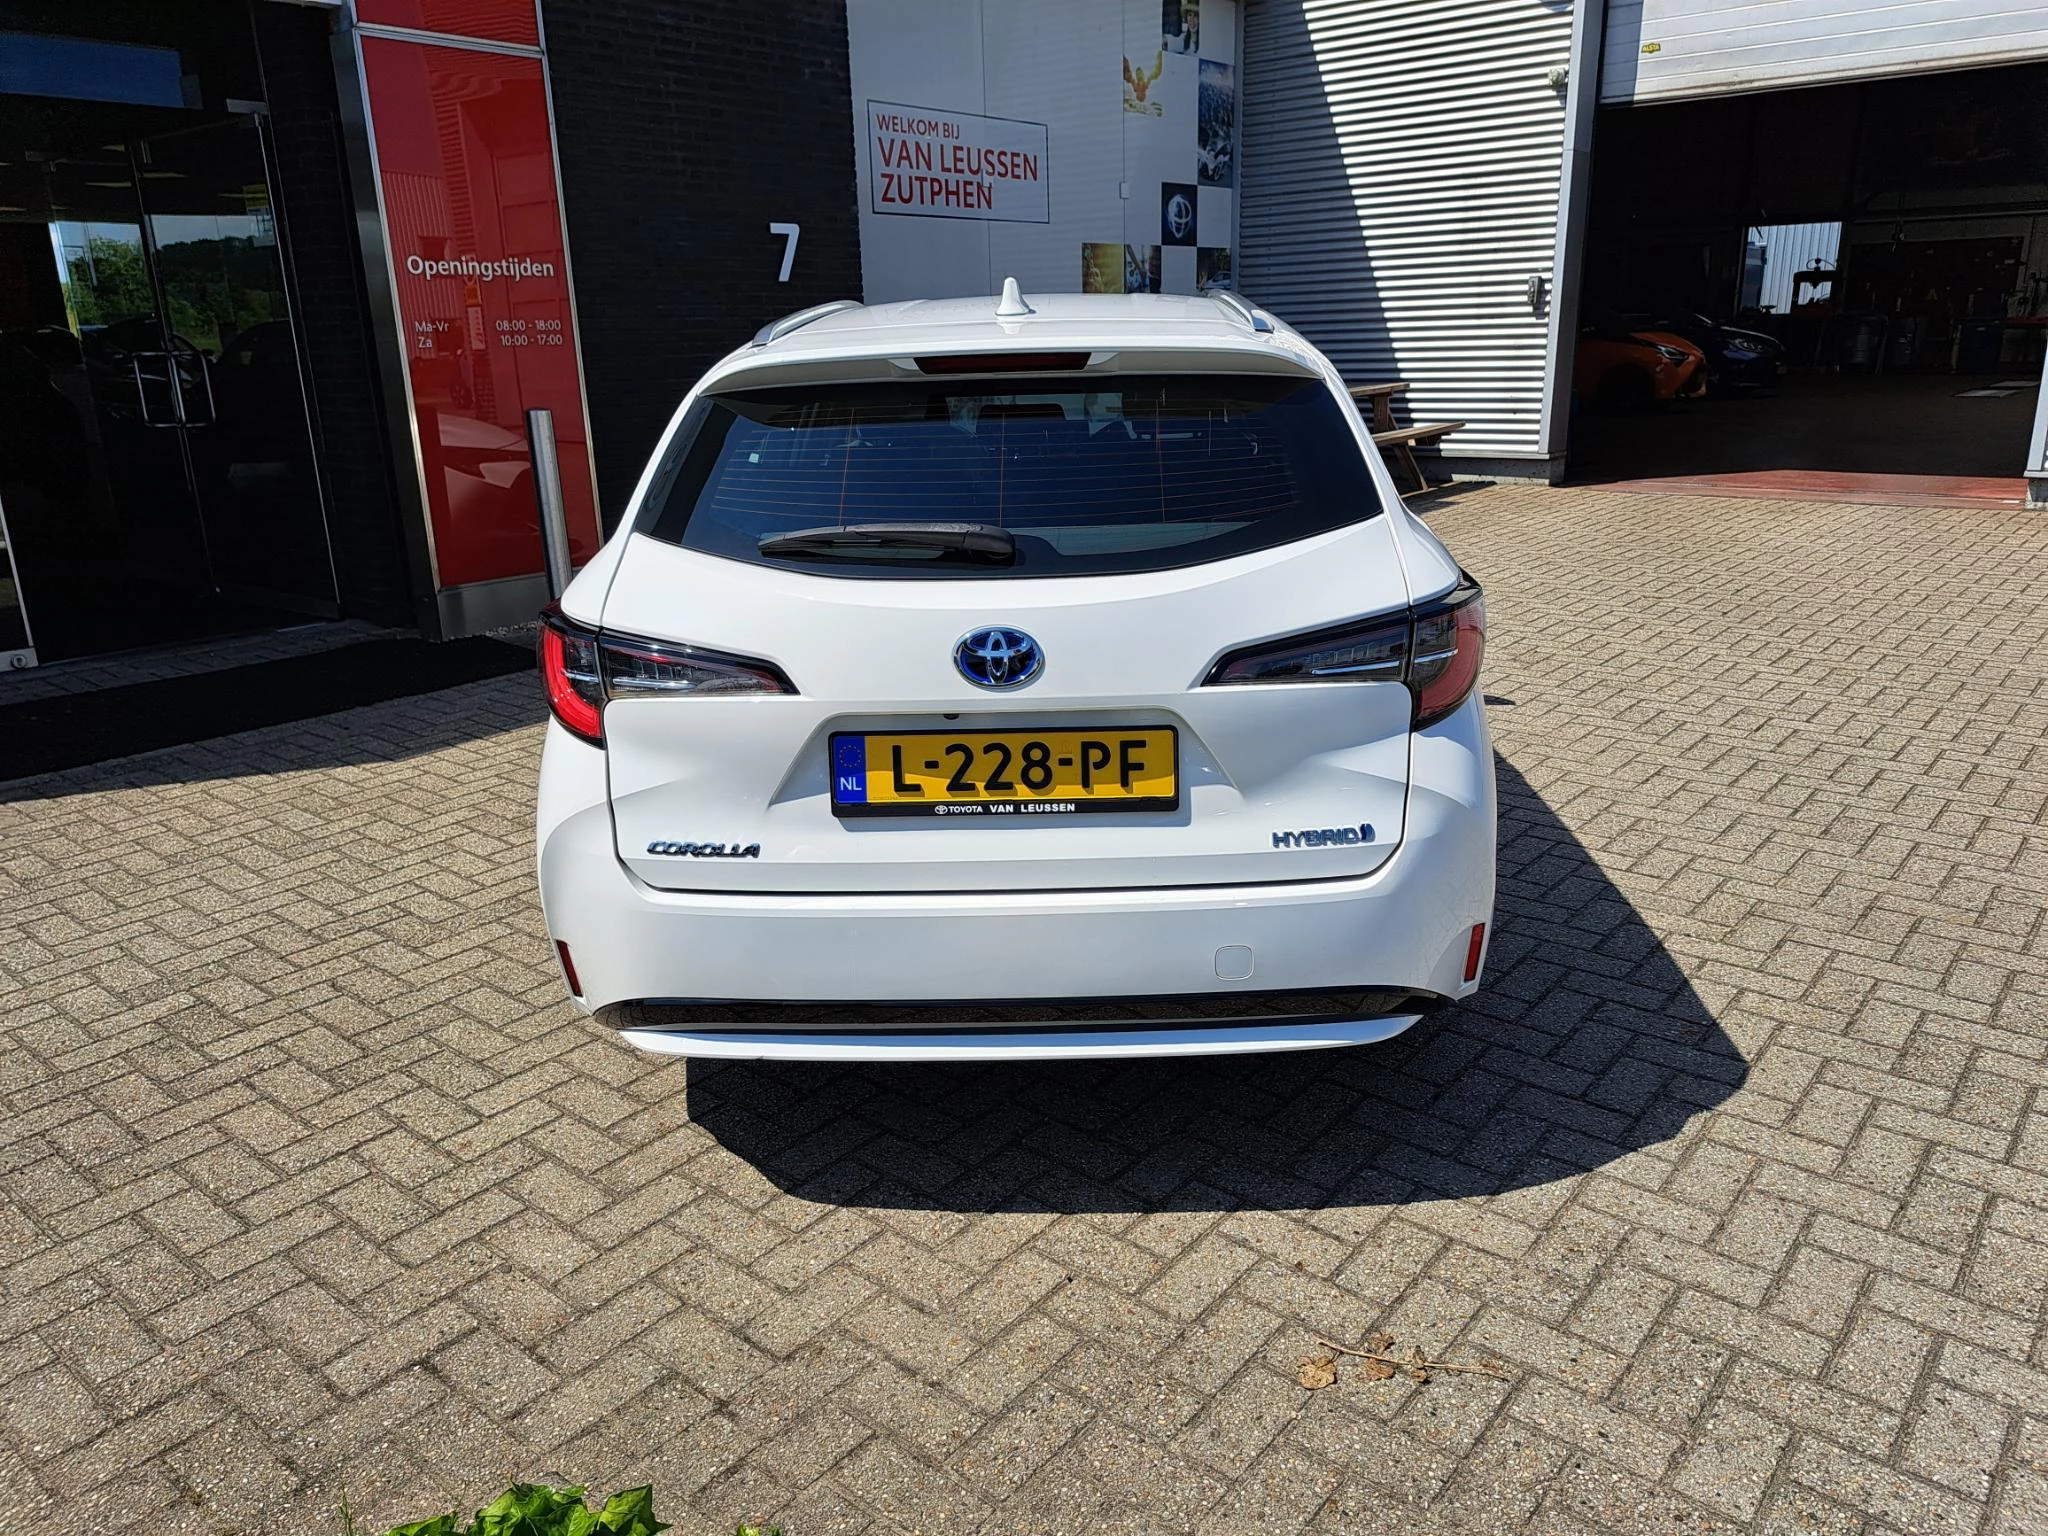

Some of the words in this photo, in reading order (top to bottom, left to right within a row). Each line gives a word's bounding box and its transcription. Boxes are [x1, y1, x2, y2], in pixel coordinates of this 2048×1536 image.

[876, 114, 939, 137] WELKOM
[942, 122, 960, 139] BIJ
[877, 136, 933, 171] VAN
[940, 144, 1038, 182] LEUSSEN
[880, 173, 993, 210] ZUTPHEN
[770, 222, 800, 282] 7
[406, 255, 555, 281] Openingstijden
[415, 321, 449, 333] Ma-Vr
[496, 320, 526, 331] 08:00
[535, 320, 561, 331] 18:00
[418, 336, 433, 348] Za
[501, 335, 528, 346] 10:00
[537, 334, 563, 345] 17:00
[892, 739, 1147, 793] L-228-PF
[840, 776, 862, 791] NL
[949, 805, 983, 813] TOYOTA
[989, 804, 1014, 813] VAN
[1020, 803, 1076, 813] LEUSSEN
[647, 840, 760, 858] COROLLA
[1272, 826, 1361, 849] HYBRID
